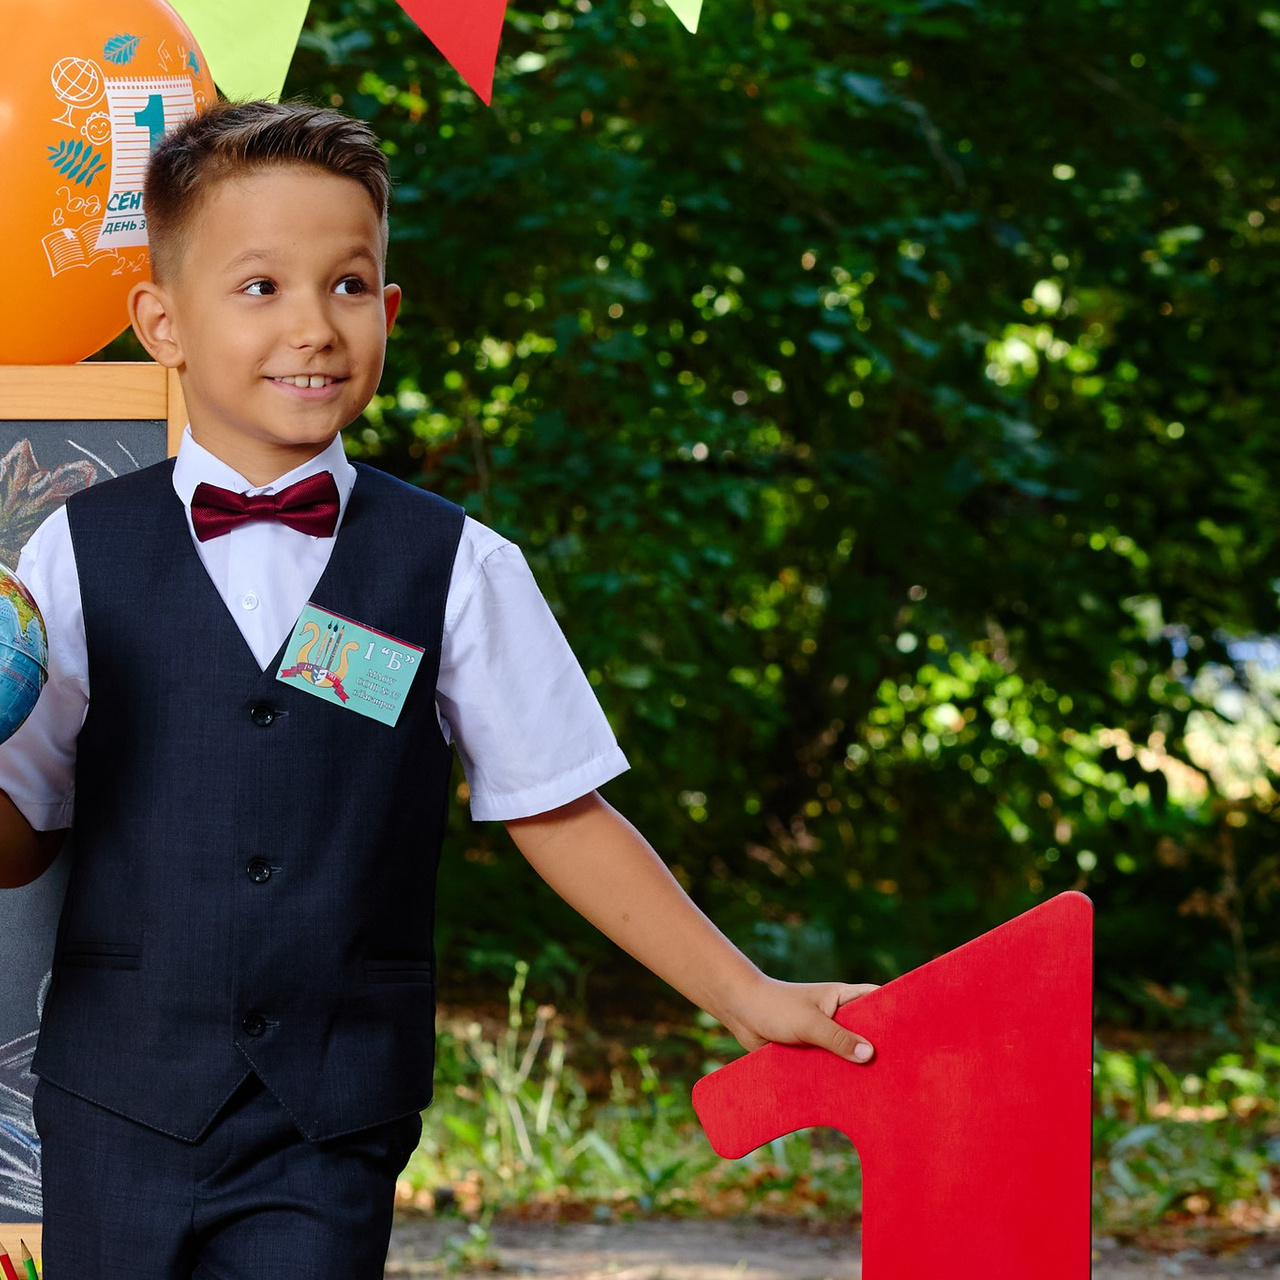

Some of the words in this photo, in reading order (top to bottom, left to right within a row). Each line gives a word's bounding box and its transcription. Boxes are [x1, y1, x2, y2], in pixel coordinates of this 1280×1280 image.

[106, 191, 144, 212] СЕН
[102, 221, 137, 236] ДЕНЬ
[364, 642, 375, 660] 1
